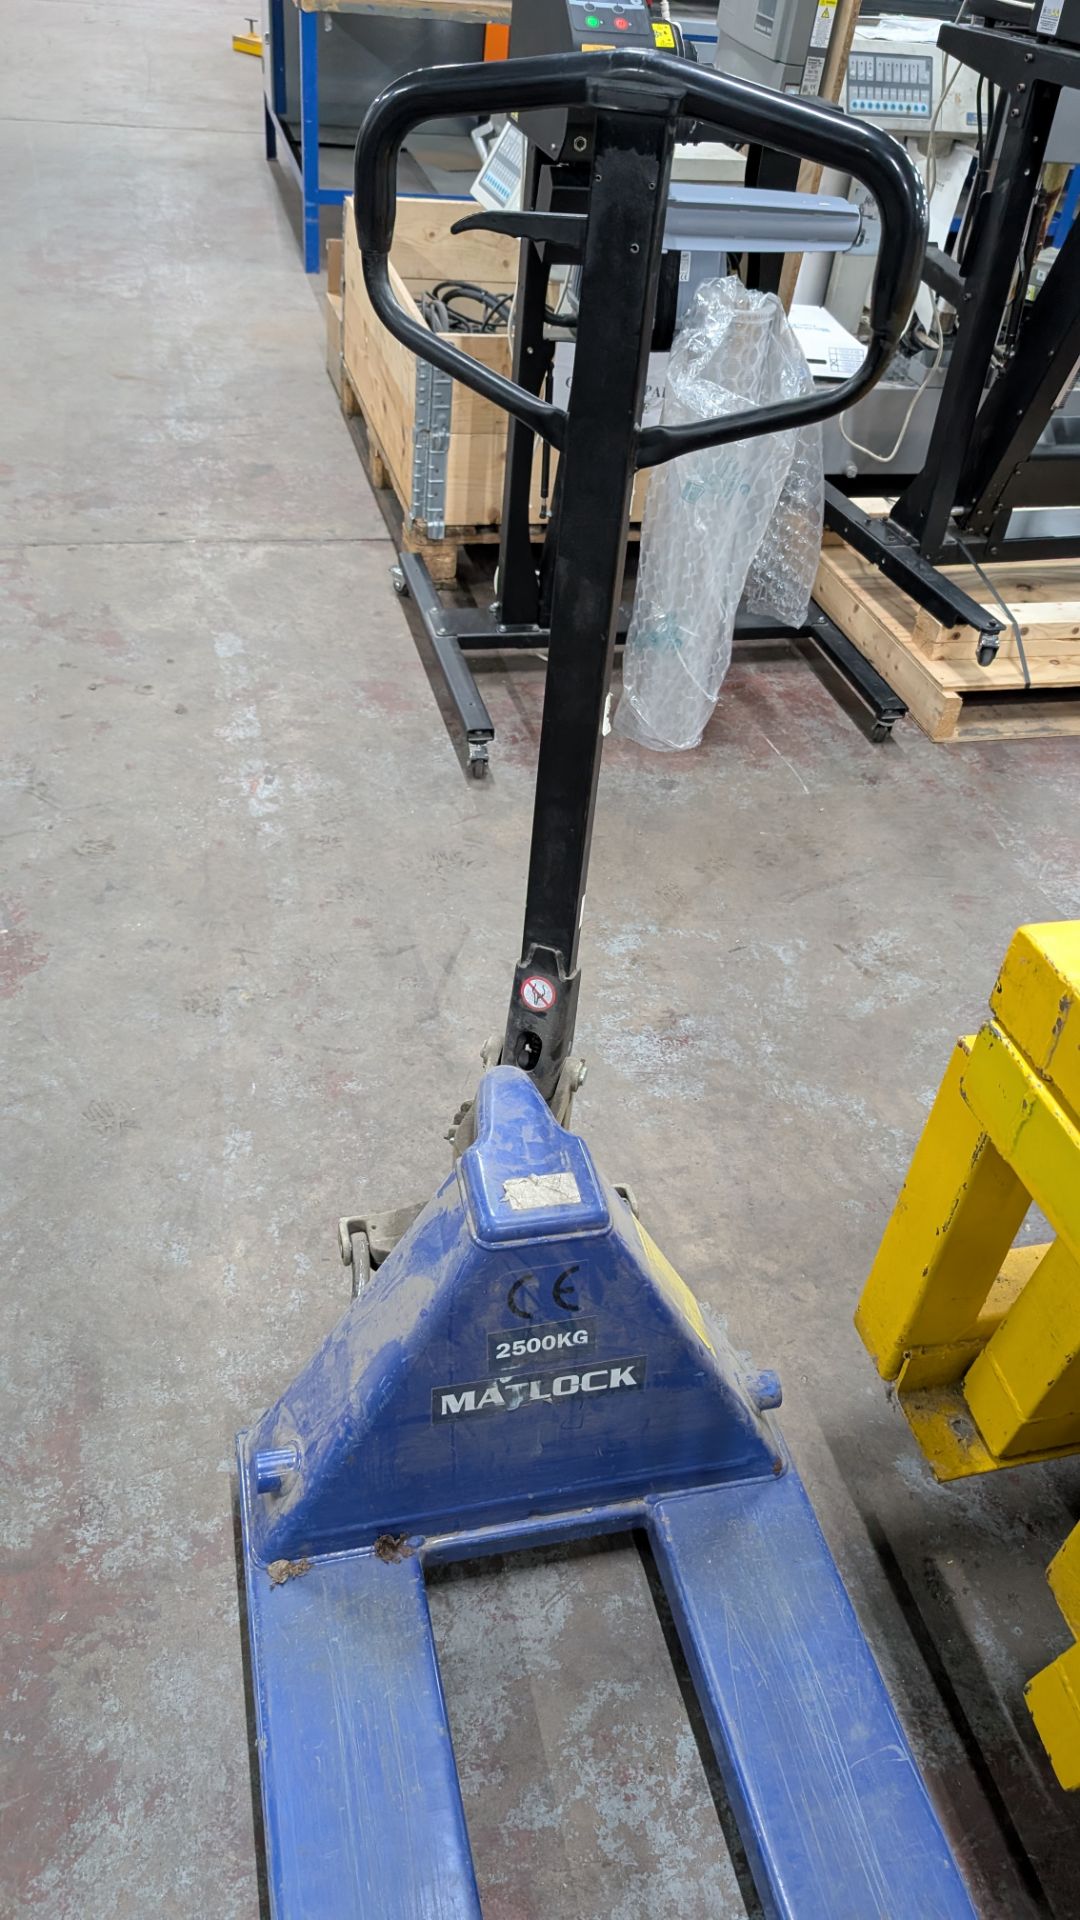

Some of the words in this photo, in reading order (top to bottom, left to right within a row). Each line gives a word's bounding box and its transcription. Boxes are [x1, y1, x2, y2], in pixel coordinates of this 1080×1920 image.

[507, 1265, 580, 1319] CE
[495, 1329, 589, 1360] 2500KG
[441, 1365, 637, 1416] MATLOCK
